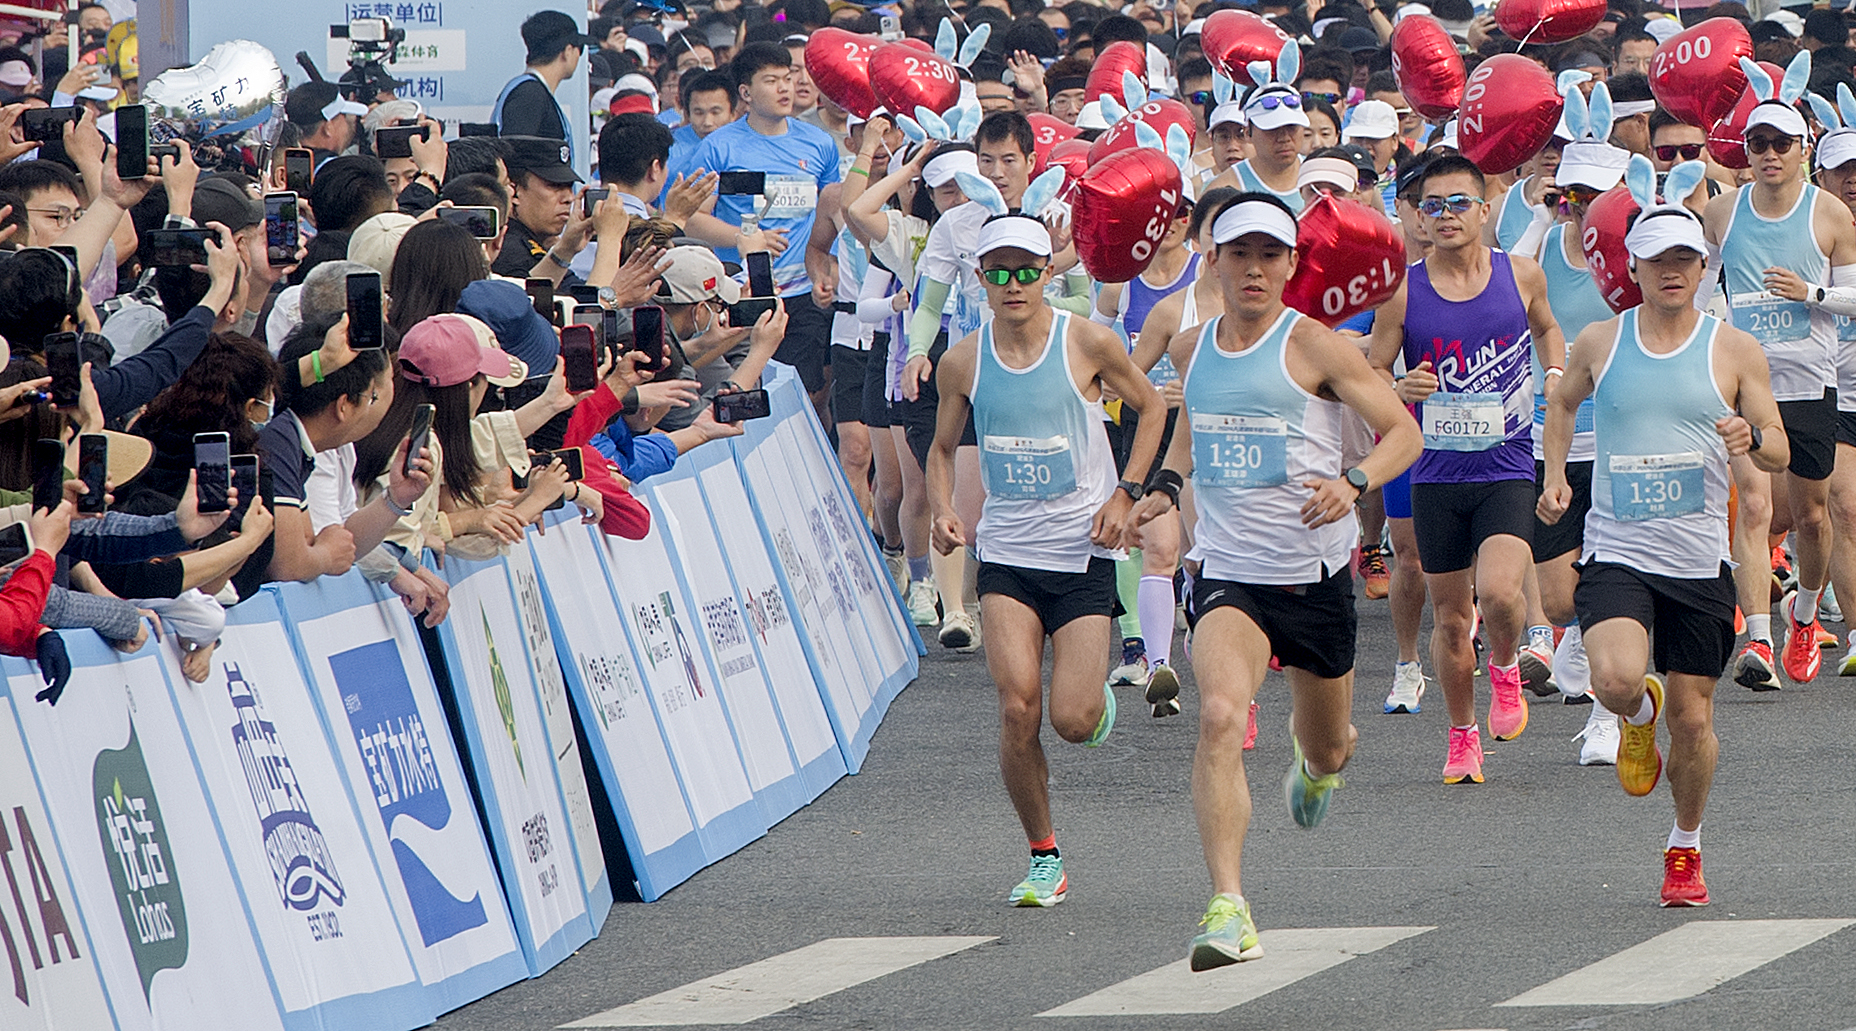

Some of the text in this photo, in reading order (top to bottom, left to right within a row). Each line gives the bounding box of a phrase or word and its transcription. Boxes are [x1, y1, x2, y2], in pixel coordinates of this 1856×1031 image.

[904, 56, 956, 84] 2:30
[1654, 35, 1712, 78] 2:00
[186, 76, 250, 116] 宝矿力
[1463, 66, 1493, 136] 2:00
[1103, 101, 1162, 146] 2:00
[1130, 188, 1178, 262] 1:30
[1322, 257, 1398, 316] 1:30
[1583, 226, 1625, 307] 1:30
[1749, 309, 1793, 332] 2:00
[1434, 421, 1490, 435] FG0172
[1003, 463, 1051, 485] 1:30
[1209, 443, 1262, 469] 1:30
[1629, 478, 1683, 505] 1:30
[359, 713, 440, 808] 宝矿力水特
[103, 794, 170, 892] 悦活
[127, 890, 176, 945] Lohas
